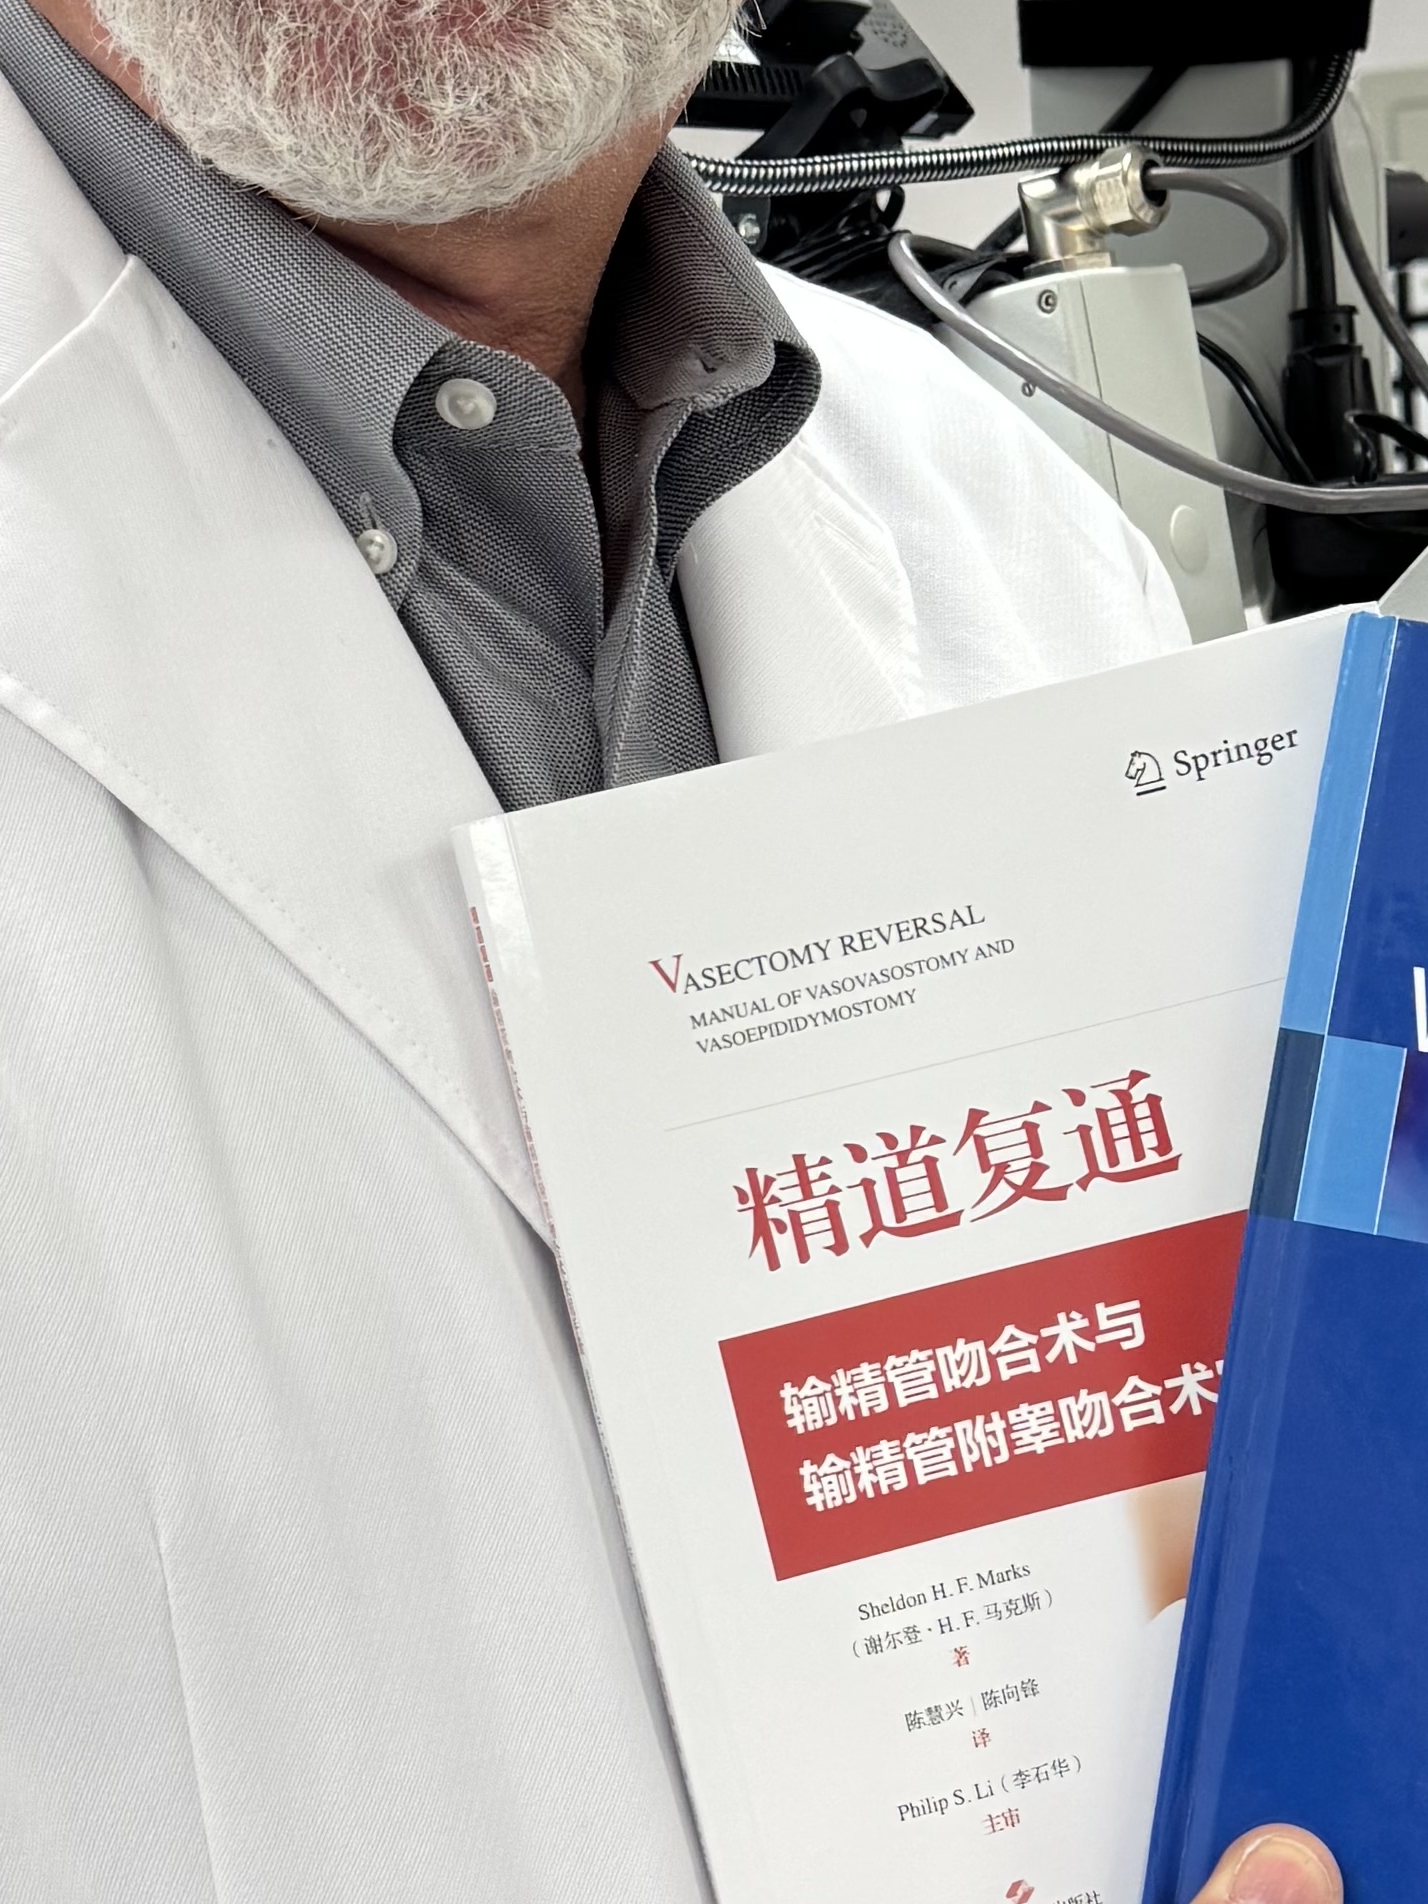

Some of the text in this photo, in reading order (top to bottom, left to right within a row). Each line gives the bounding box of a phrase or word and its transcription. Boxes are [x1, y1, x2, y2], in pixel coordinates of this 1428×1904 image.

[1172, 725, 1299, 782] Springer
[649, 904, 986, 995] VASECTOMY REVERSAL
[689, 938, 1015, 1030] MANUAL OF VASOVASOSTOMY AND
[695, 988, 916, 1054] VASOEPIDIDYMOSTOMY
[733, 1069, 1183, 1272] 精道复通
[779, 1299, 1146, 1435] 输精管吻合术与
[798, 1359, 1225, 1512] 输精管附睾吻合术
[858, 1563, 1031, 1621] Sheldon H. F. Marks
[951, 1645, 971, 1668] 著
[972, 1727, 991, 1749] 译
[897, 1796, 949, 1823] Philip
[953, 1788, 972, 1806] S.
[974, 1780, 995, 1800] Li
